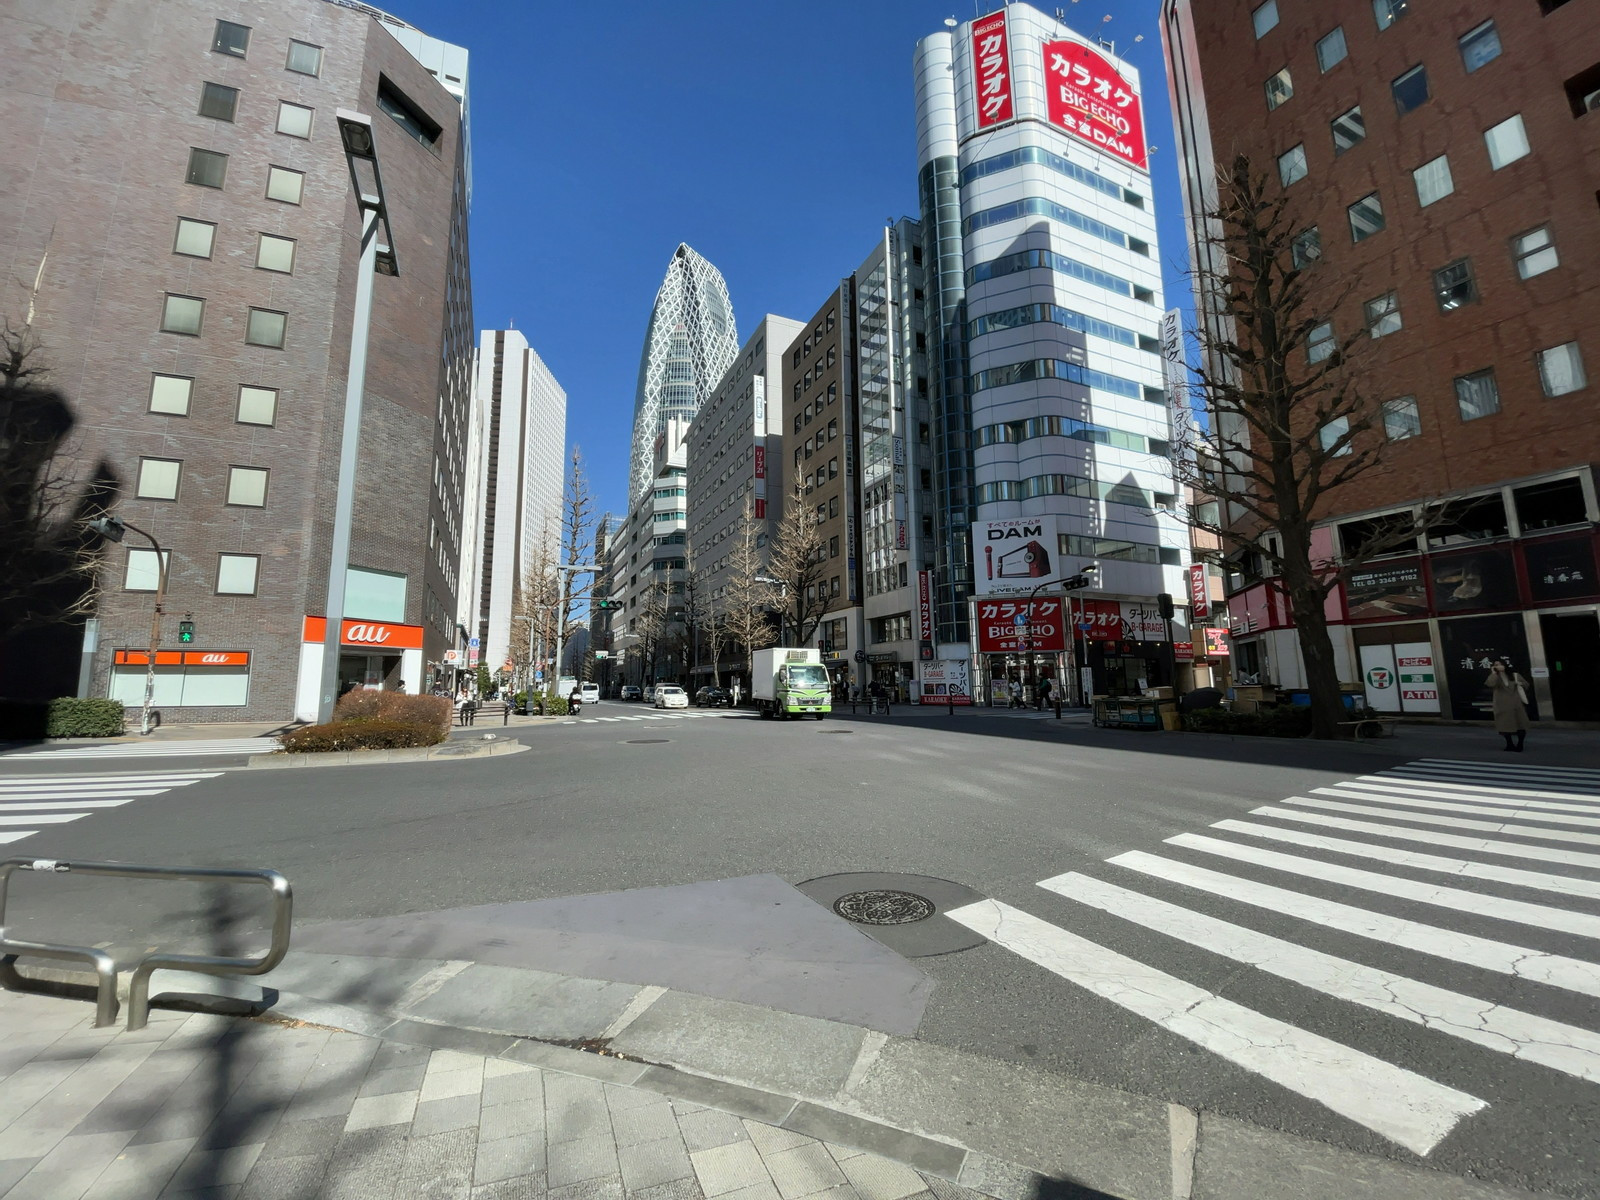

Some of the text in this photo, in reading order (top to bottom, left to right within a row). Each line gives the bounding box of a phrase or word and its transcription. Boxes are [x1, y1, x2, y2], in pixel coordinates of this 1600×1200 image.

[975, 27, 987, 36] BIG
[988, 20, 1004, 30] ECHO
[980, 34, 1008, 117] カラオケ
[1051, 53, 1133, 107] カラオケ
[1060, 85, 1130, 134] BIG ECHO
[1063, 114, 1133, 158] 全室DAM
[1165, 314, 1180, 362] カラオケ
[988, 525, 1042, 541] DAM
[1193, 571, 1205, 612] カラオケ
[921, 602, 930, 638] カラオケ
[982, 602, 1058, 619] カラオケ
[1073, 611, 1120, 626] カラオケ
[347, 624, 391, 643] au
[989, 626, 1014, 639] BIG
[202, 653, 230, 663] au
[1406, 691, 1434, 699] ATM
